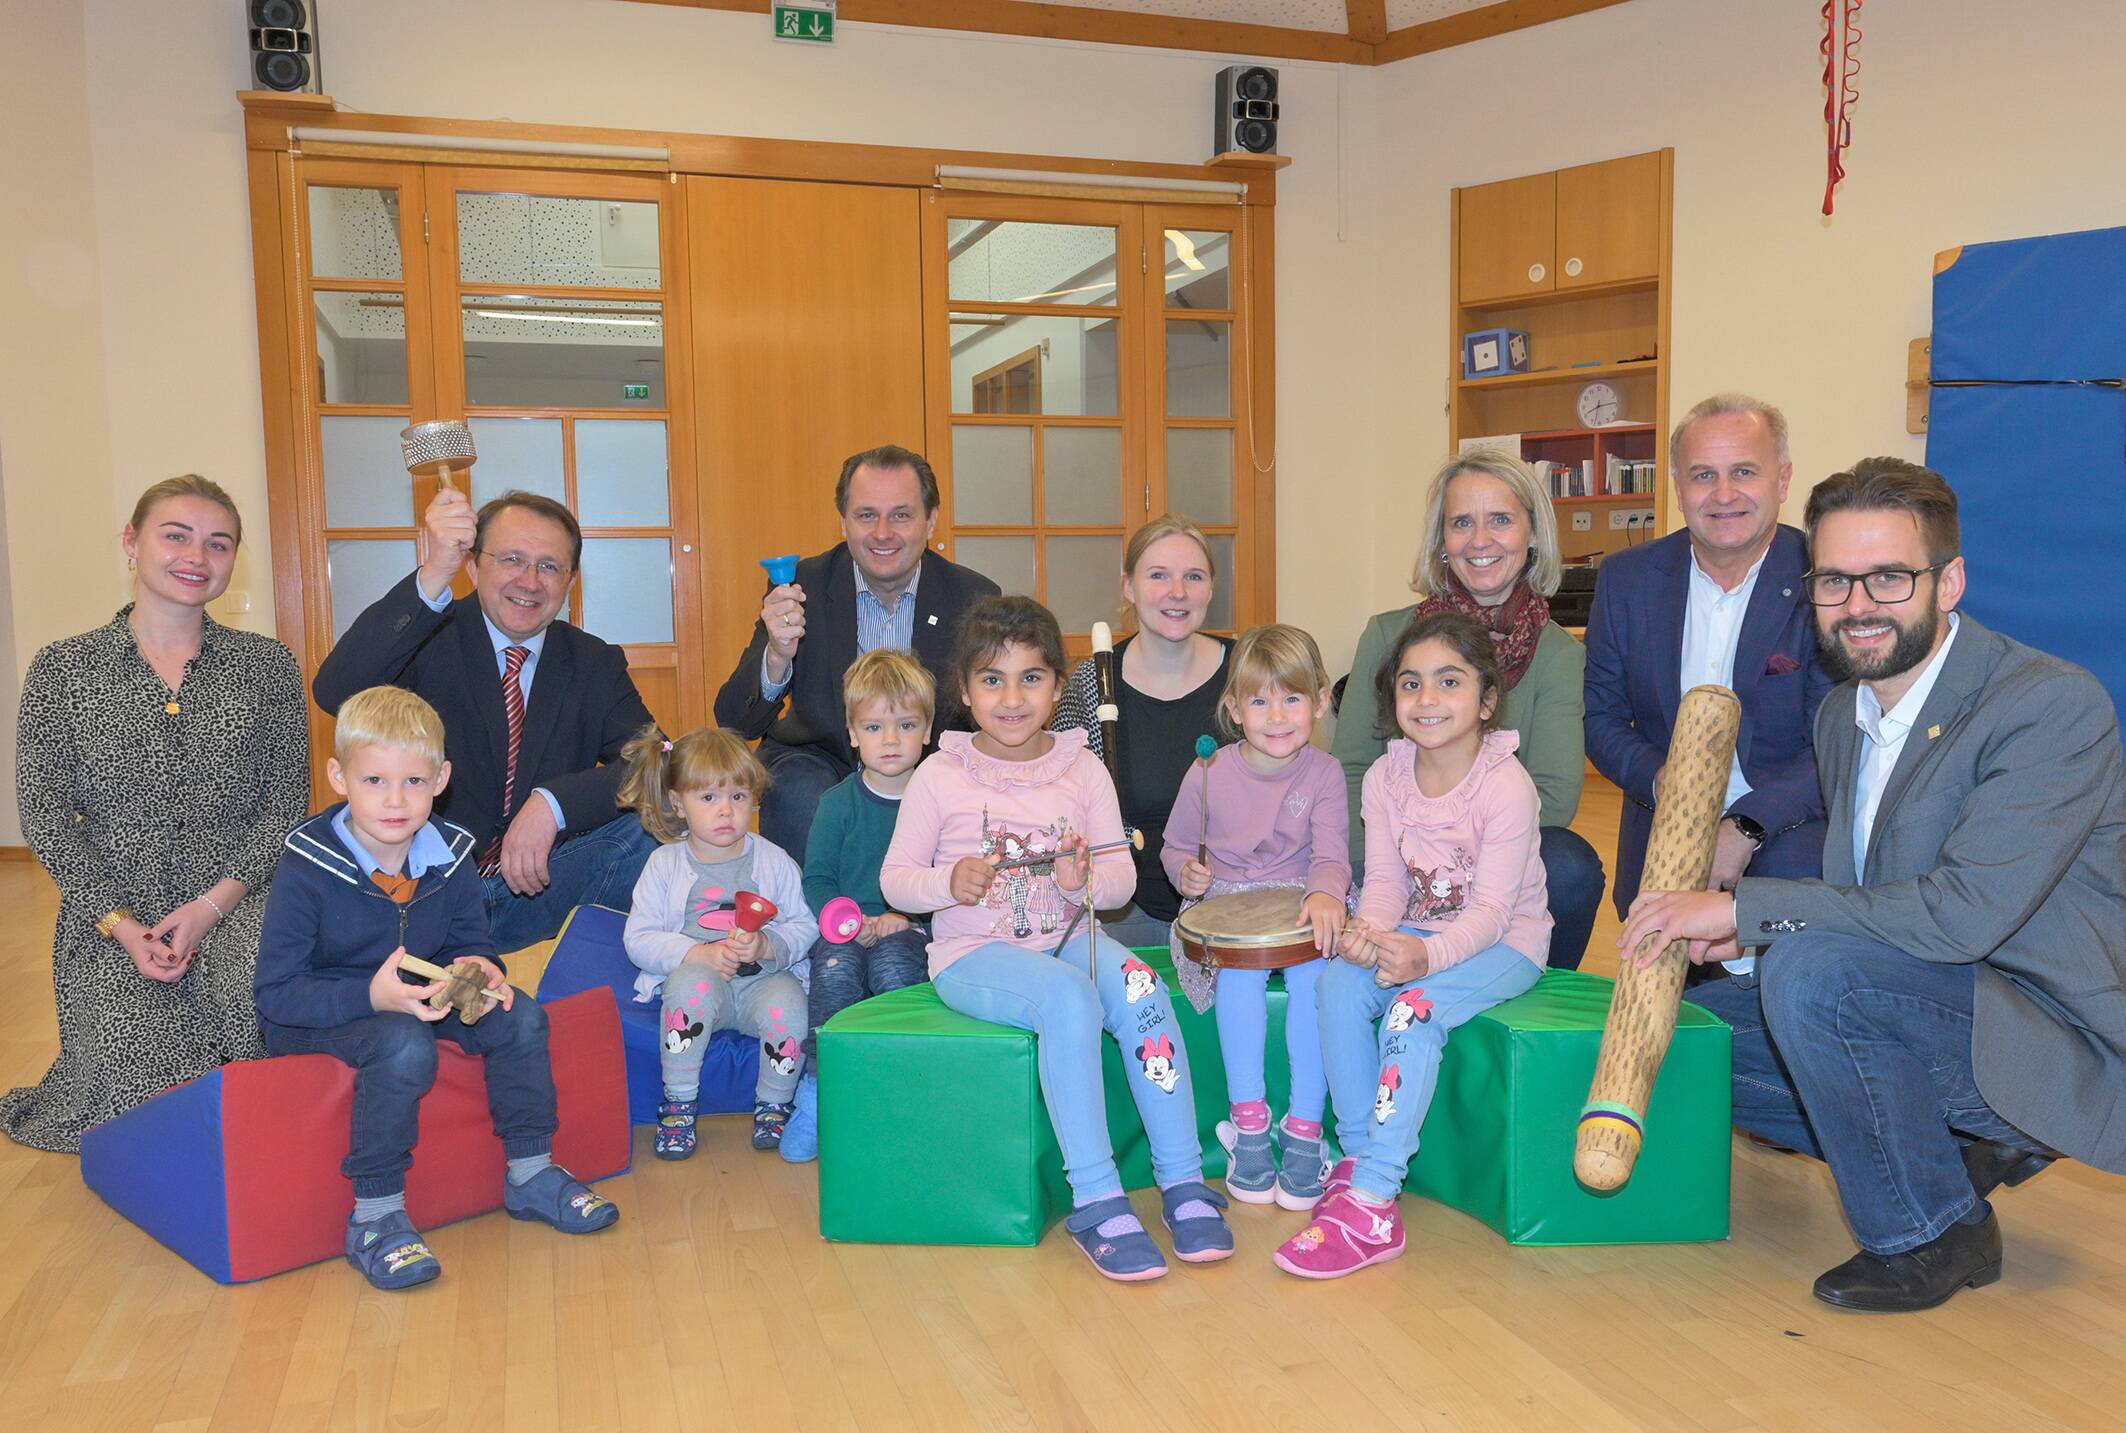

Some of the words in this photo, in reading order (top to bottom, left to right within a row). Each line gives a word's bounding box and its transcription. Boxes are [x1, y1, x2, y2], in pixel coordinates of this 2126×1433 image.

[1136, 1003, 1156, 1021] HEY
[1138, 1009, 1166, 1034] GIRL!
[1382, 1043, 1407, 1060] IRL!
